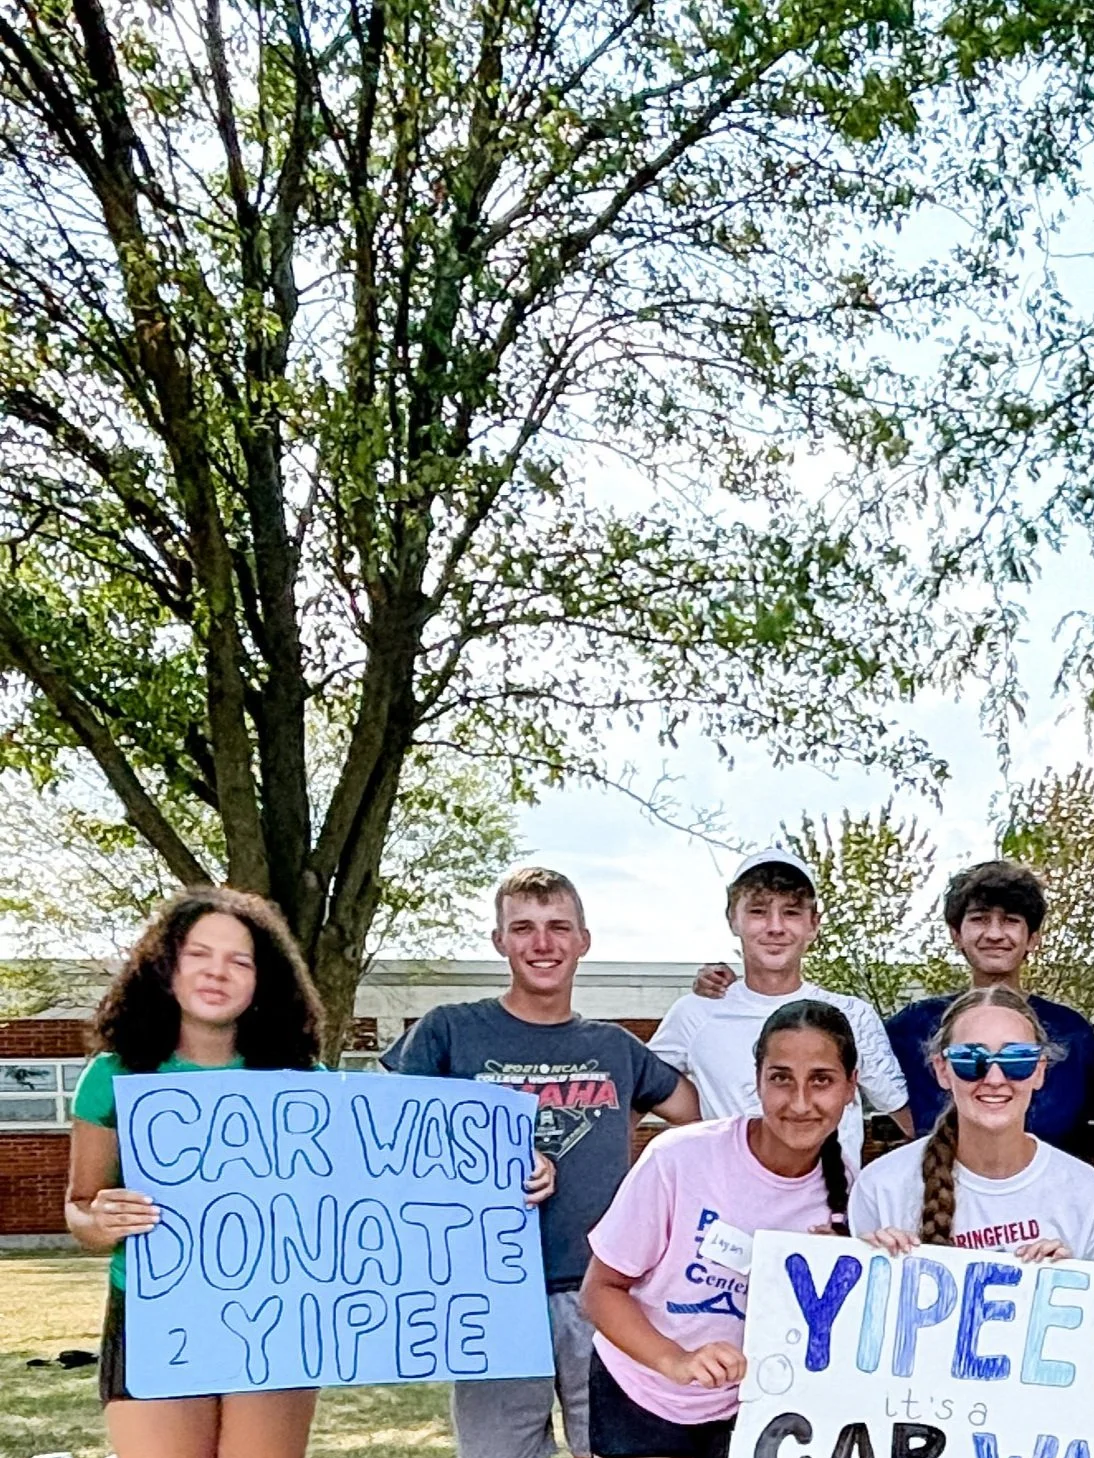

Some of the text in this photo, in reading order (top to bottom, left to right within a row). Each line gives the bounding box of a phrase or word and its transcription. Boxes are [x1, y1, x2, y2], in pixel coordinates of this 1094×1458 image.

[501, 1062, 588, 1074] 2021 NCAA
[129, 1087, 537, 1192] CAR WASH
[134, 1191, 530, 1300] DONATE
[952, 1218, 1041, 1250] RINGFIELD
[167, 1289, 490, 1386] 2 YIPEE
[885, 1386, 989, 1427] it's a
